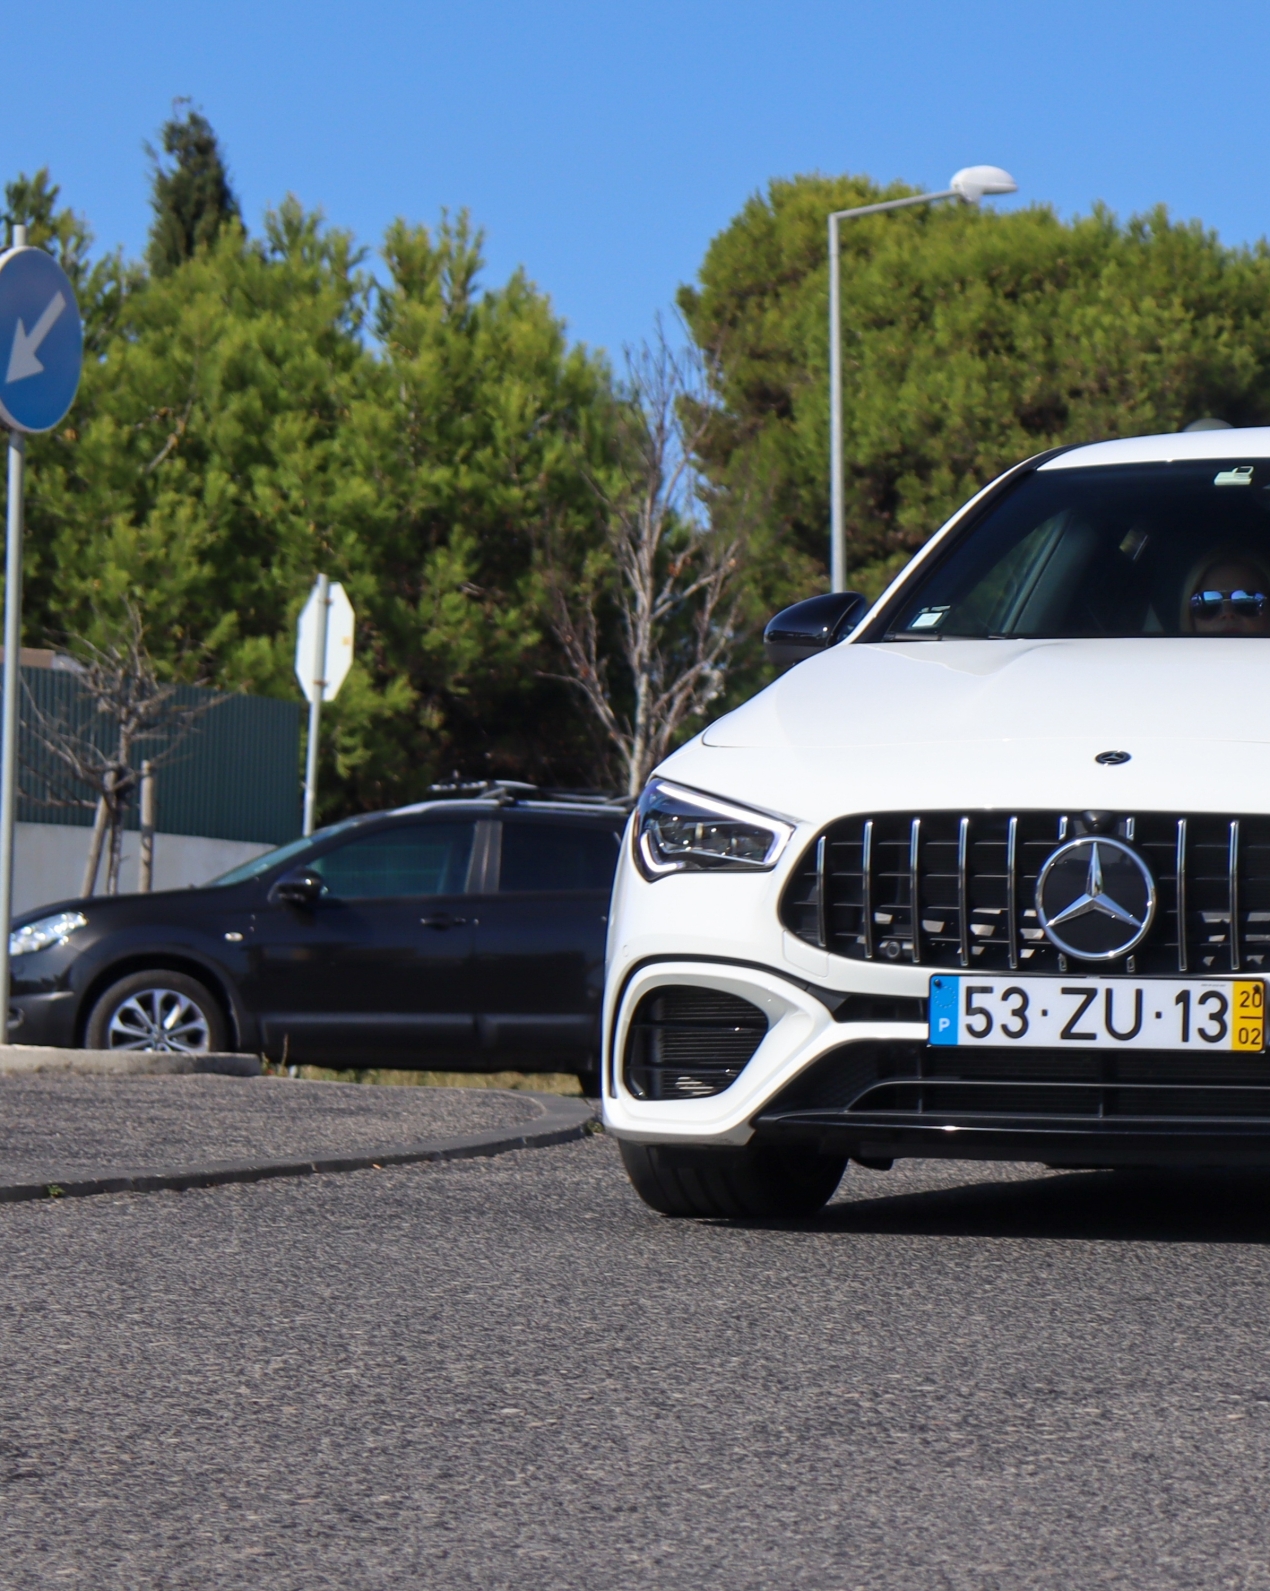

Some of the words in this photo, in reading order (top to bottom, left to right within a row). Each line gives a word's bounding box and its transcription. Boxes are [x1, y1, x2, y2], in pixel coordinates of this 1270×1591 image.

[1239, 990, 1263, 1008] 20
[938, 1017, 951, 1033] P
[1238, 1026, 1262, 1046] 02
